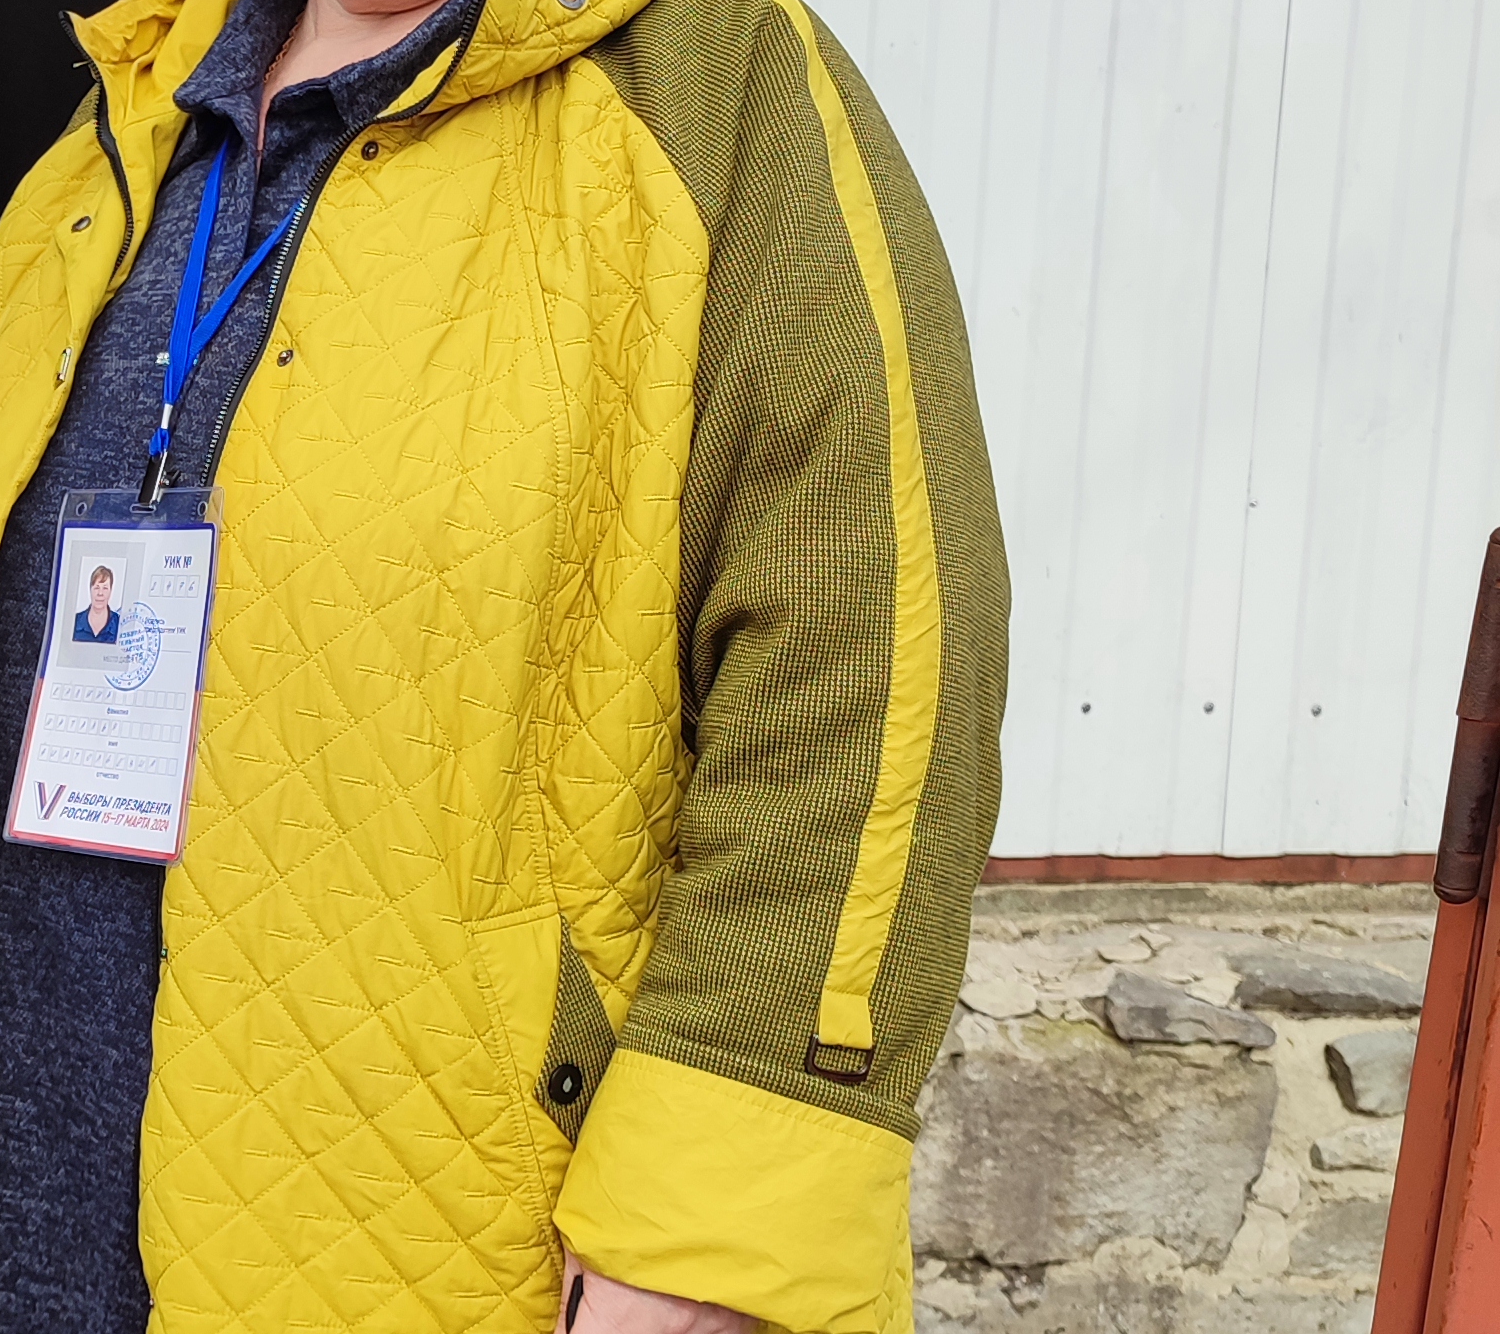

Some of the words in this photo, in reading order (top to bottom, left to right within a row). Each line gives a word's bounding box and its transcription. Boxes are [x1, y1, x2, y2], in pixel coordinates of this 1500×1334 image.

[164, 555, 182, 568] УИК
[67, 791, 113, 808] ВЫБОРЫ
[112, 797, 172, 816] ПРЕЗИДЕНТА
[59, 806, 101, 823] РОССИИ
[123, 815, 150, 830] МАРТА
[150, 818, 170, 832] 2024
